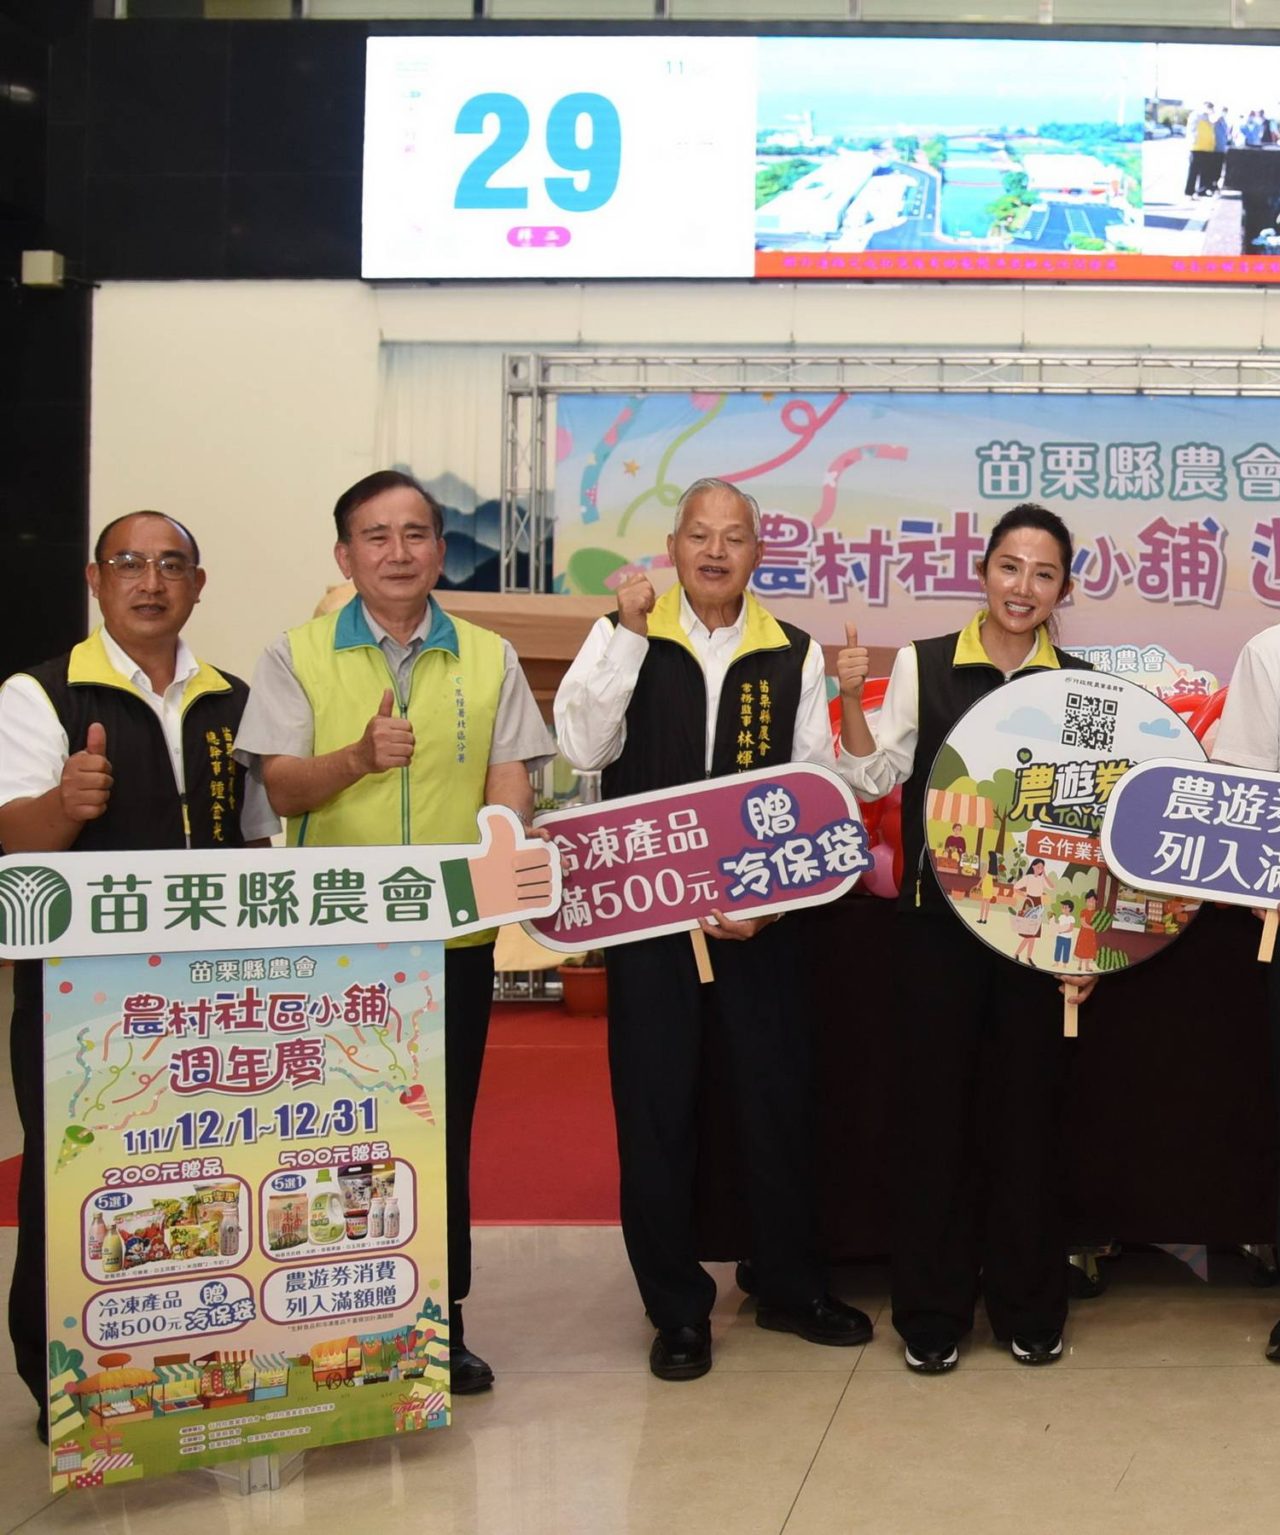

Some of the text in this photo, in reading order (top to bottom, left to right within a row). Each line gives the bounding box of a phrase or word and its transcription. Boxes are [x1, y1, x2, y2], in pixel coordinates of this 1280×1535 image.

[454, 92, 622, 213] 29
[751, 511, 1224, 606] 農村社小舖
[736, 730, 755, 773] 林輝
[747, 787, 797, 840] 贈
[554, 823, 869, 932] 滿500元 冷保袋
[86, 866, 437, 934] 苗栗縣農會
[189, 956, 317, 984] 苗栗縣農會
[122, 981, 390, 1038] 農村社區小舖
[168, 1037, 326, 1098] 週年慶
[123, 1097, 378, 1155] 111/12/1~12/31
[103, 1157, 223, 1186] 200元贈品
[279, 1141, 391, 1167] 500元贈品
[98, 1193, 129, 1209] 5選1
[273, 1175, 303, 1190] 5選1
[285, 1260, 397, 1294] 農遊券消費
[98, 1284, 227, 1318] 冷凍產品 贈
[285, 1285, 398, 1319] 列入滿額贈
[98, 1315, 182, 1342] 滿500元
